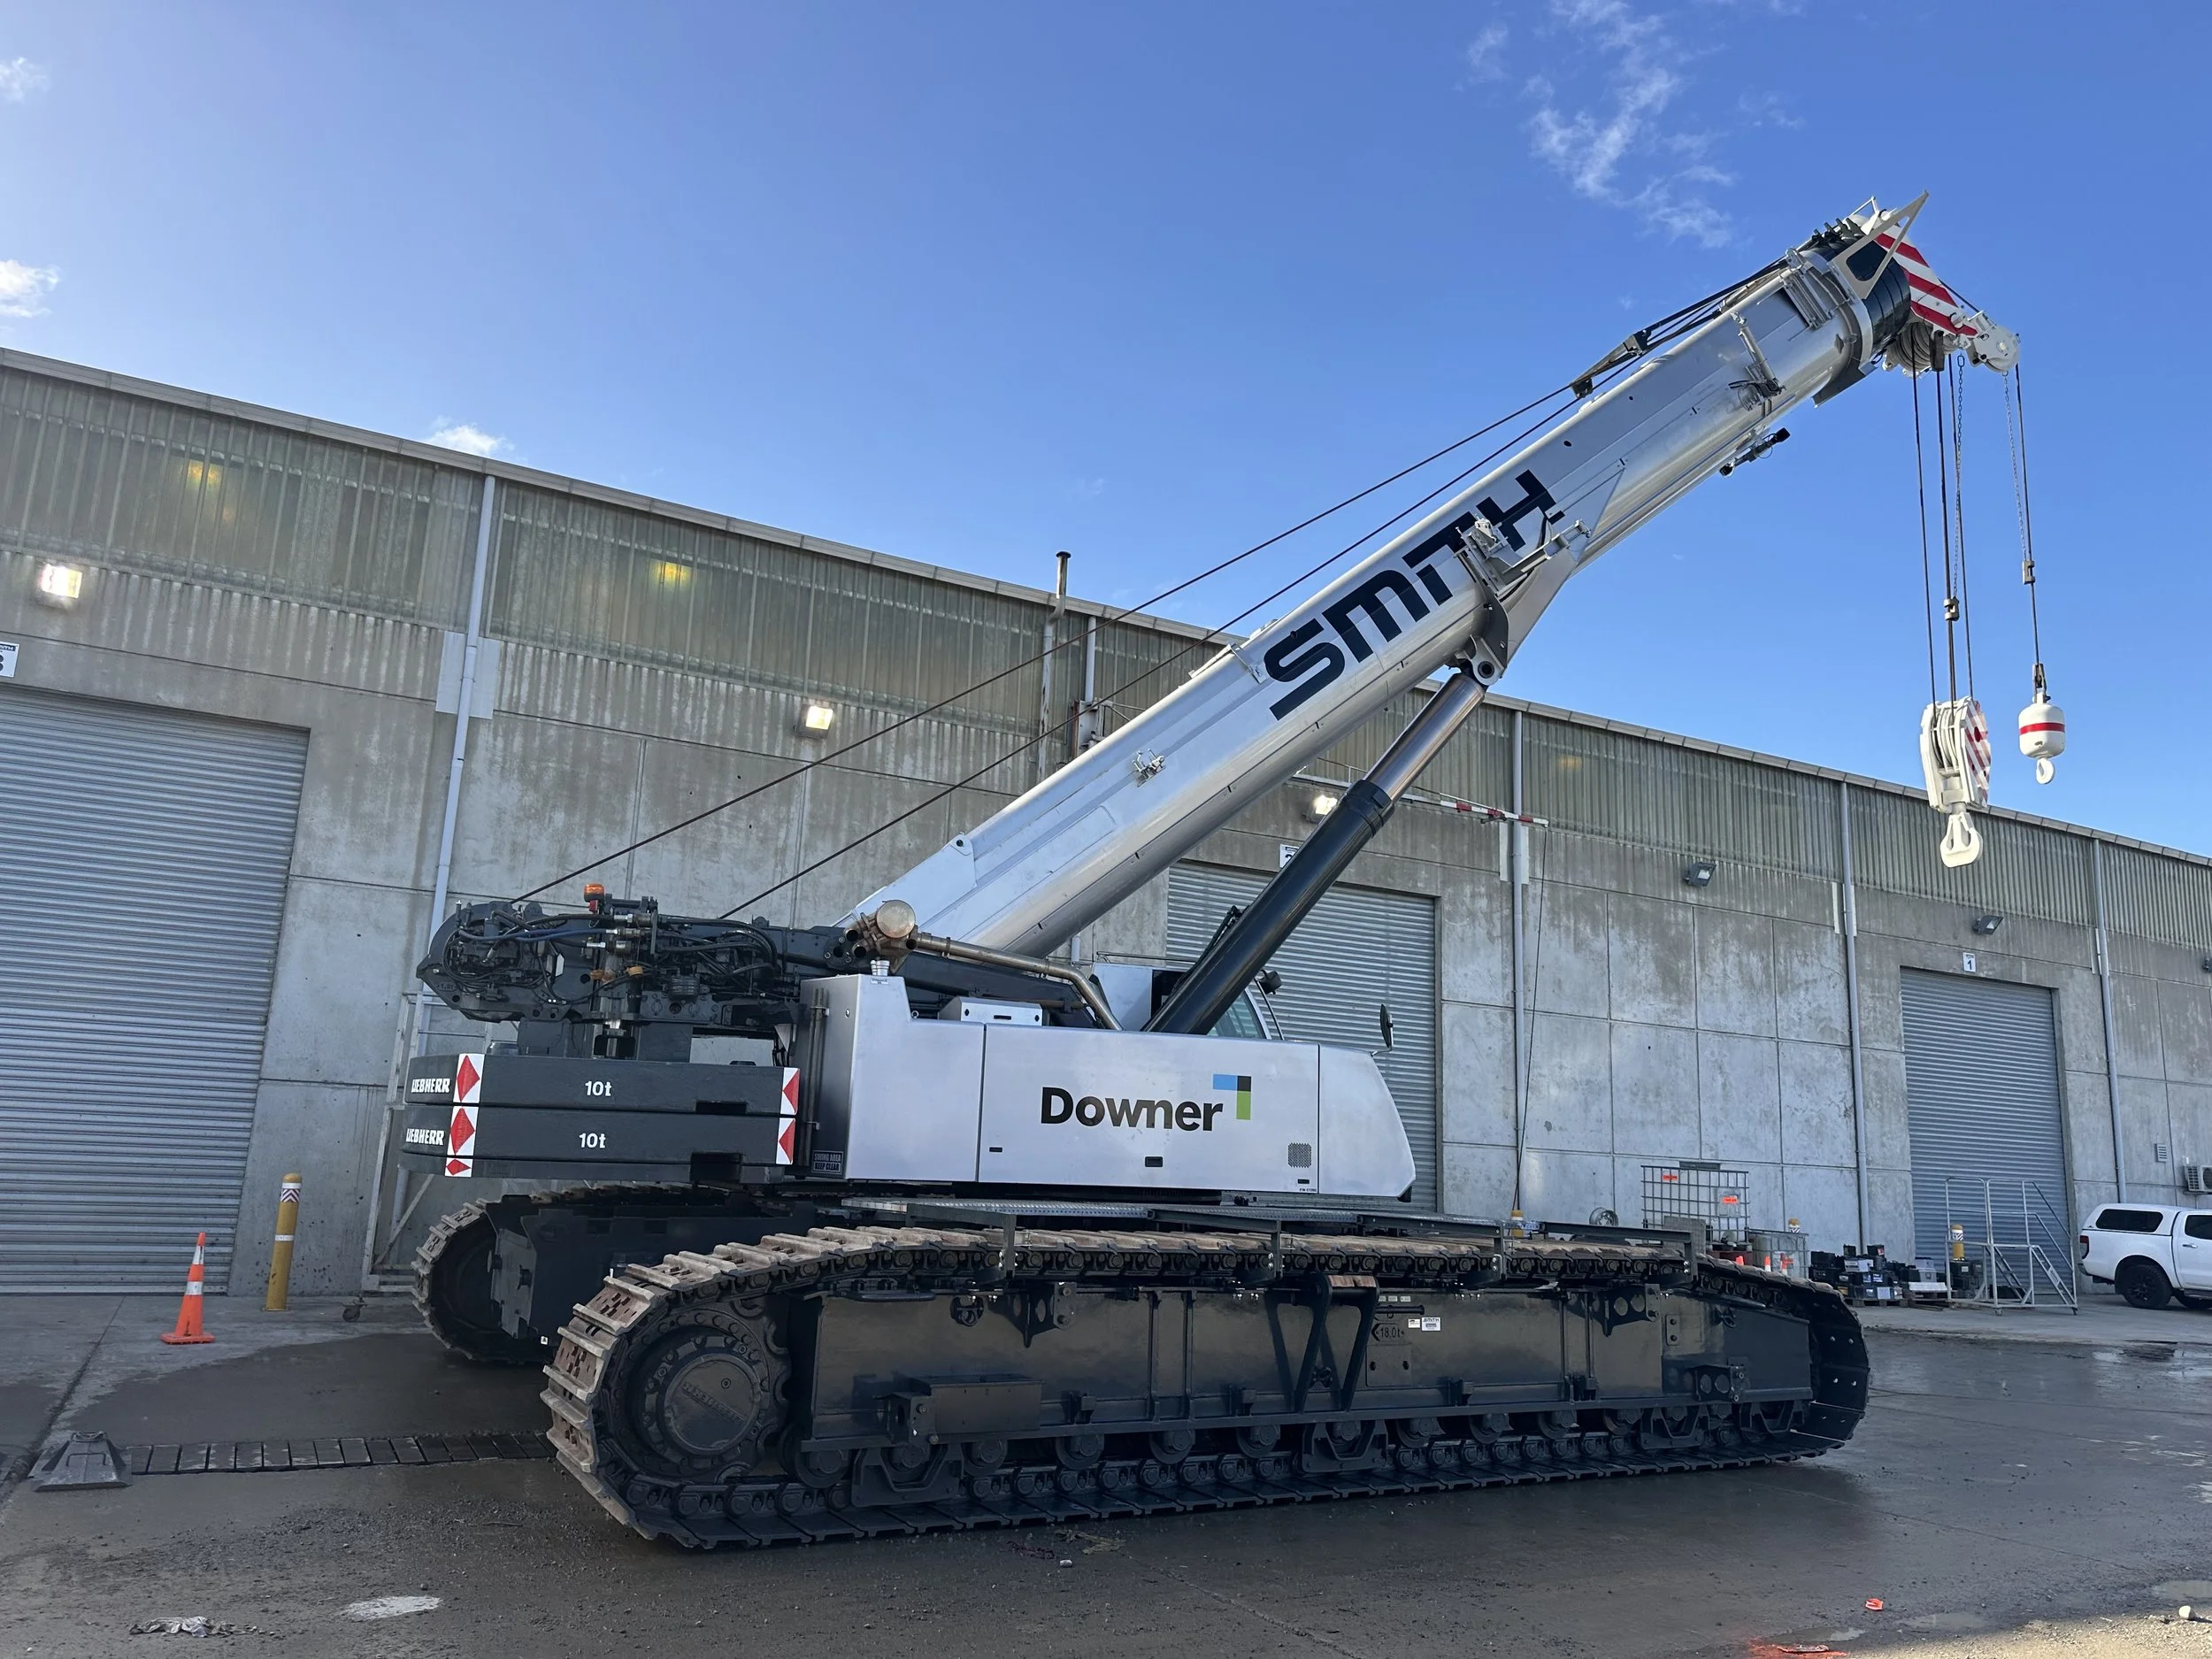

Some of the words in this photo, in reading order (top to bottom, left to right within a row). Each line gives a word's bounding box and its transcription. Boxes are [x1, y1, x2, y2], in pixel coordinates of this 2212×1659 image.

[1263, 470, 1565, 720] SMITH
[1967, 959, 1972, 971] 1
[411, 1078, 451, 1094] LIEBHERR
[585, 1080, 612, 1096] 10t
[1041, 1087, 1224, 1132] Downer
[405, 1128, 445, 1146] LIEBHERR
[579, 1133, 606, 1148] 10t
[830, 1153, 841, 1162] AREA
[826, 1163, 840, 1171] CLEAR
